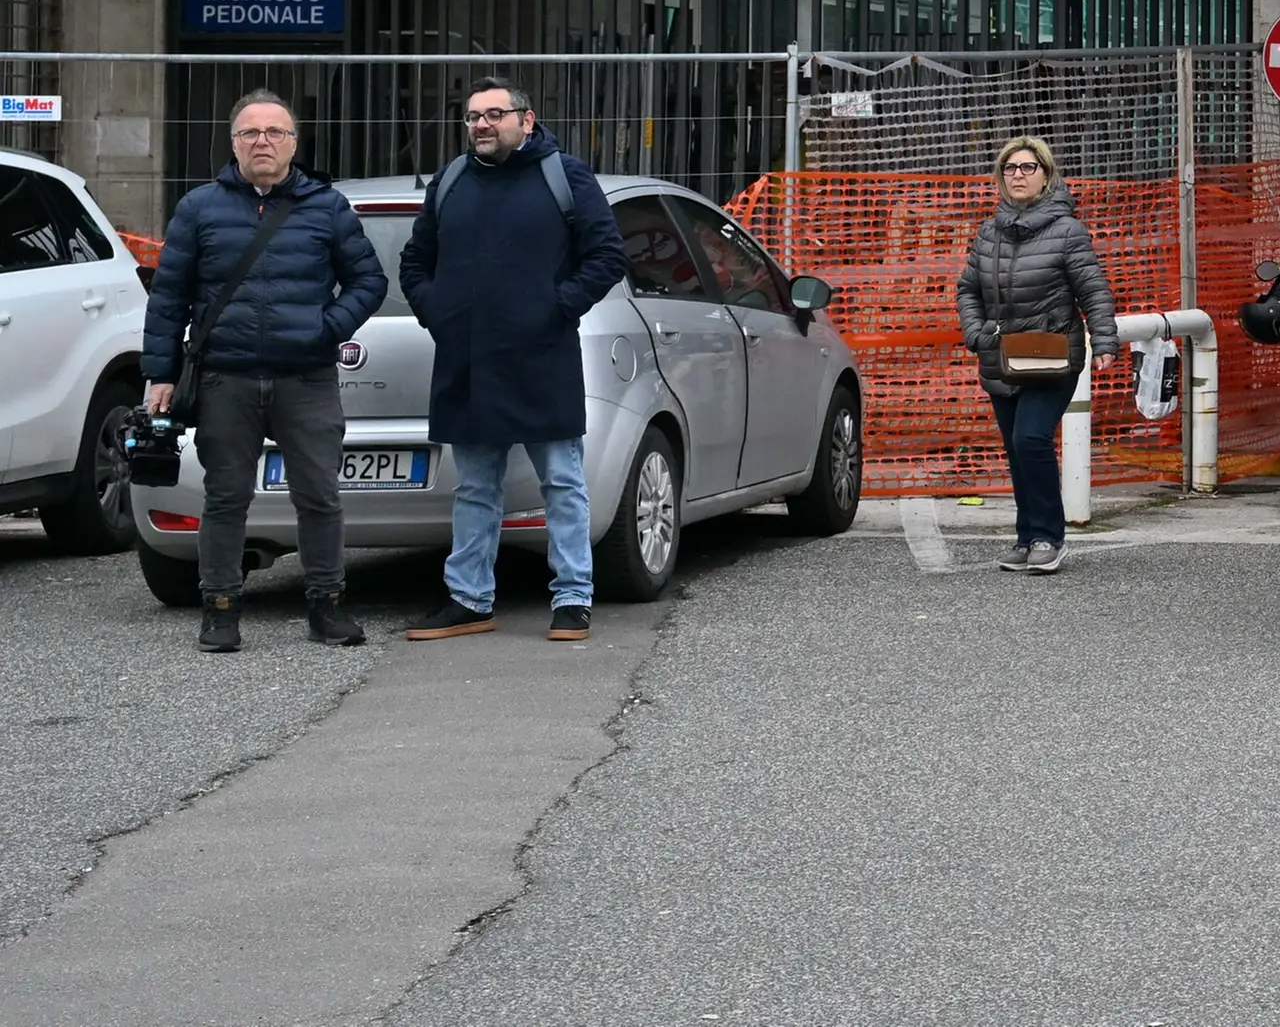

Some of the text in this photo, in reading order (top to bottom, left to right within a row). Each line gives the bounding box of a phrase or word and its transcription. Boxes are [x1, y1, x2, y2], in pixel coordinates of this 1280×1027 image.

[202, 4, 325, 24] PEDONALE
[2, 98, 54, 113] BigMat
[342, 349, 359, 362] FIAT
[340, 453, 407, 480] 62PL
